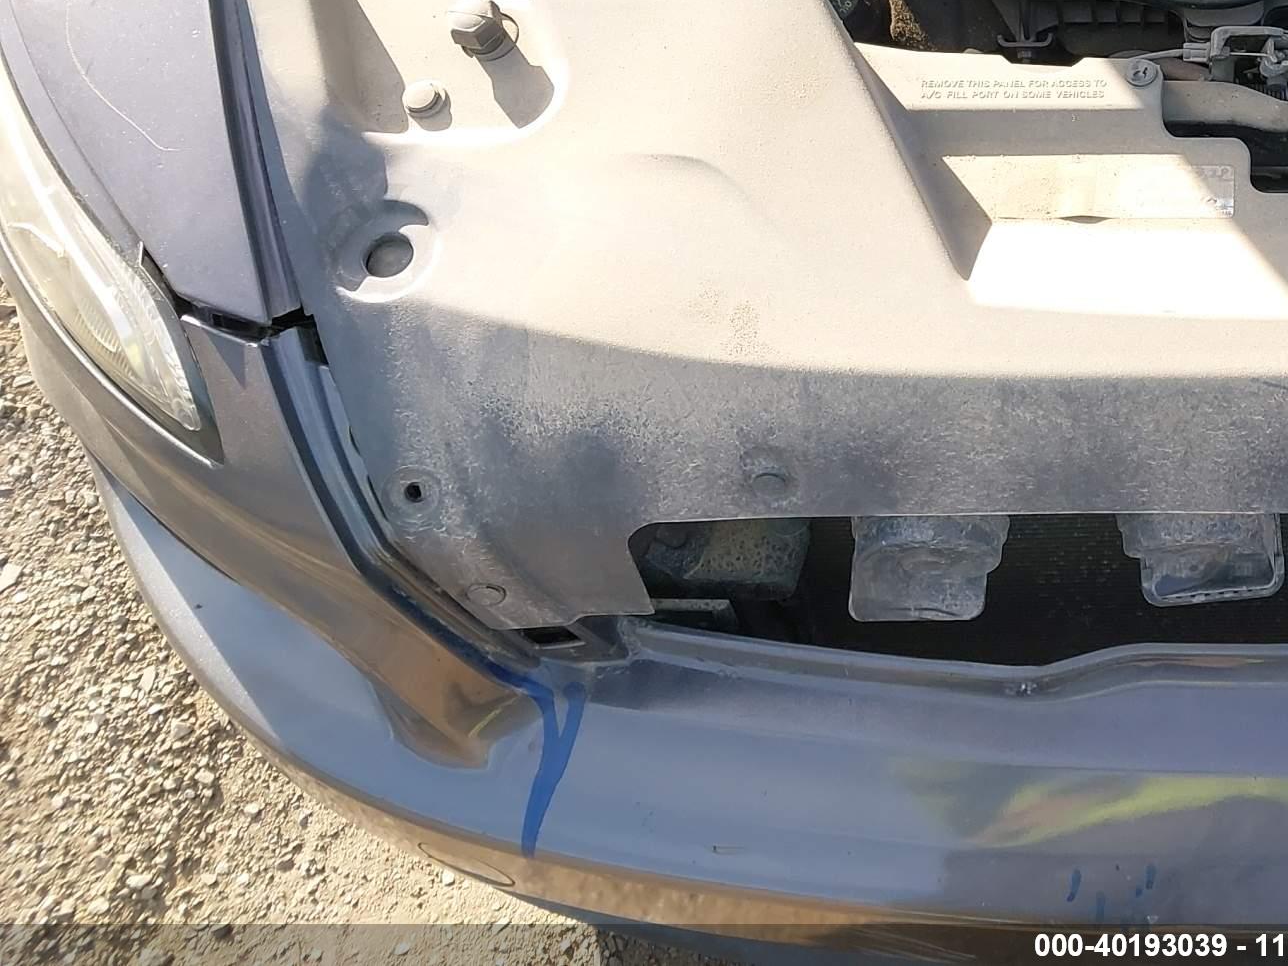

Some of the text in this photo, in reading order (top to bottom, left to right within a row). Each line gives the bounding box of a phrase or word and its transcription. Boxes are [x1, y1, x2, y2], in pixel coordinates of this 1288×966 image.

[921, 80, 1108, 88] REMOVE THIS PANEL FOR ACCESS TO
[921, 90, 1105, 99] A/C FILL PORT ON SOME VEHICLES
